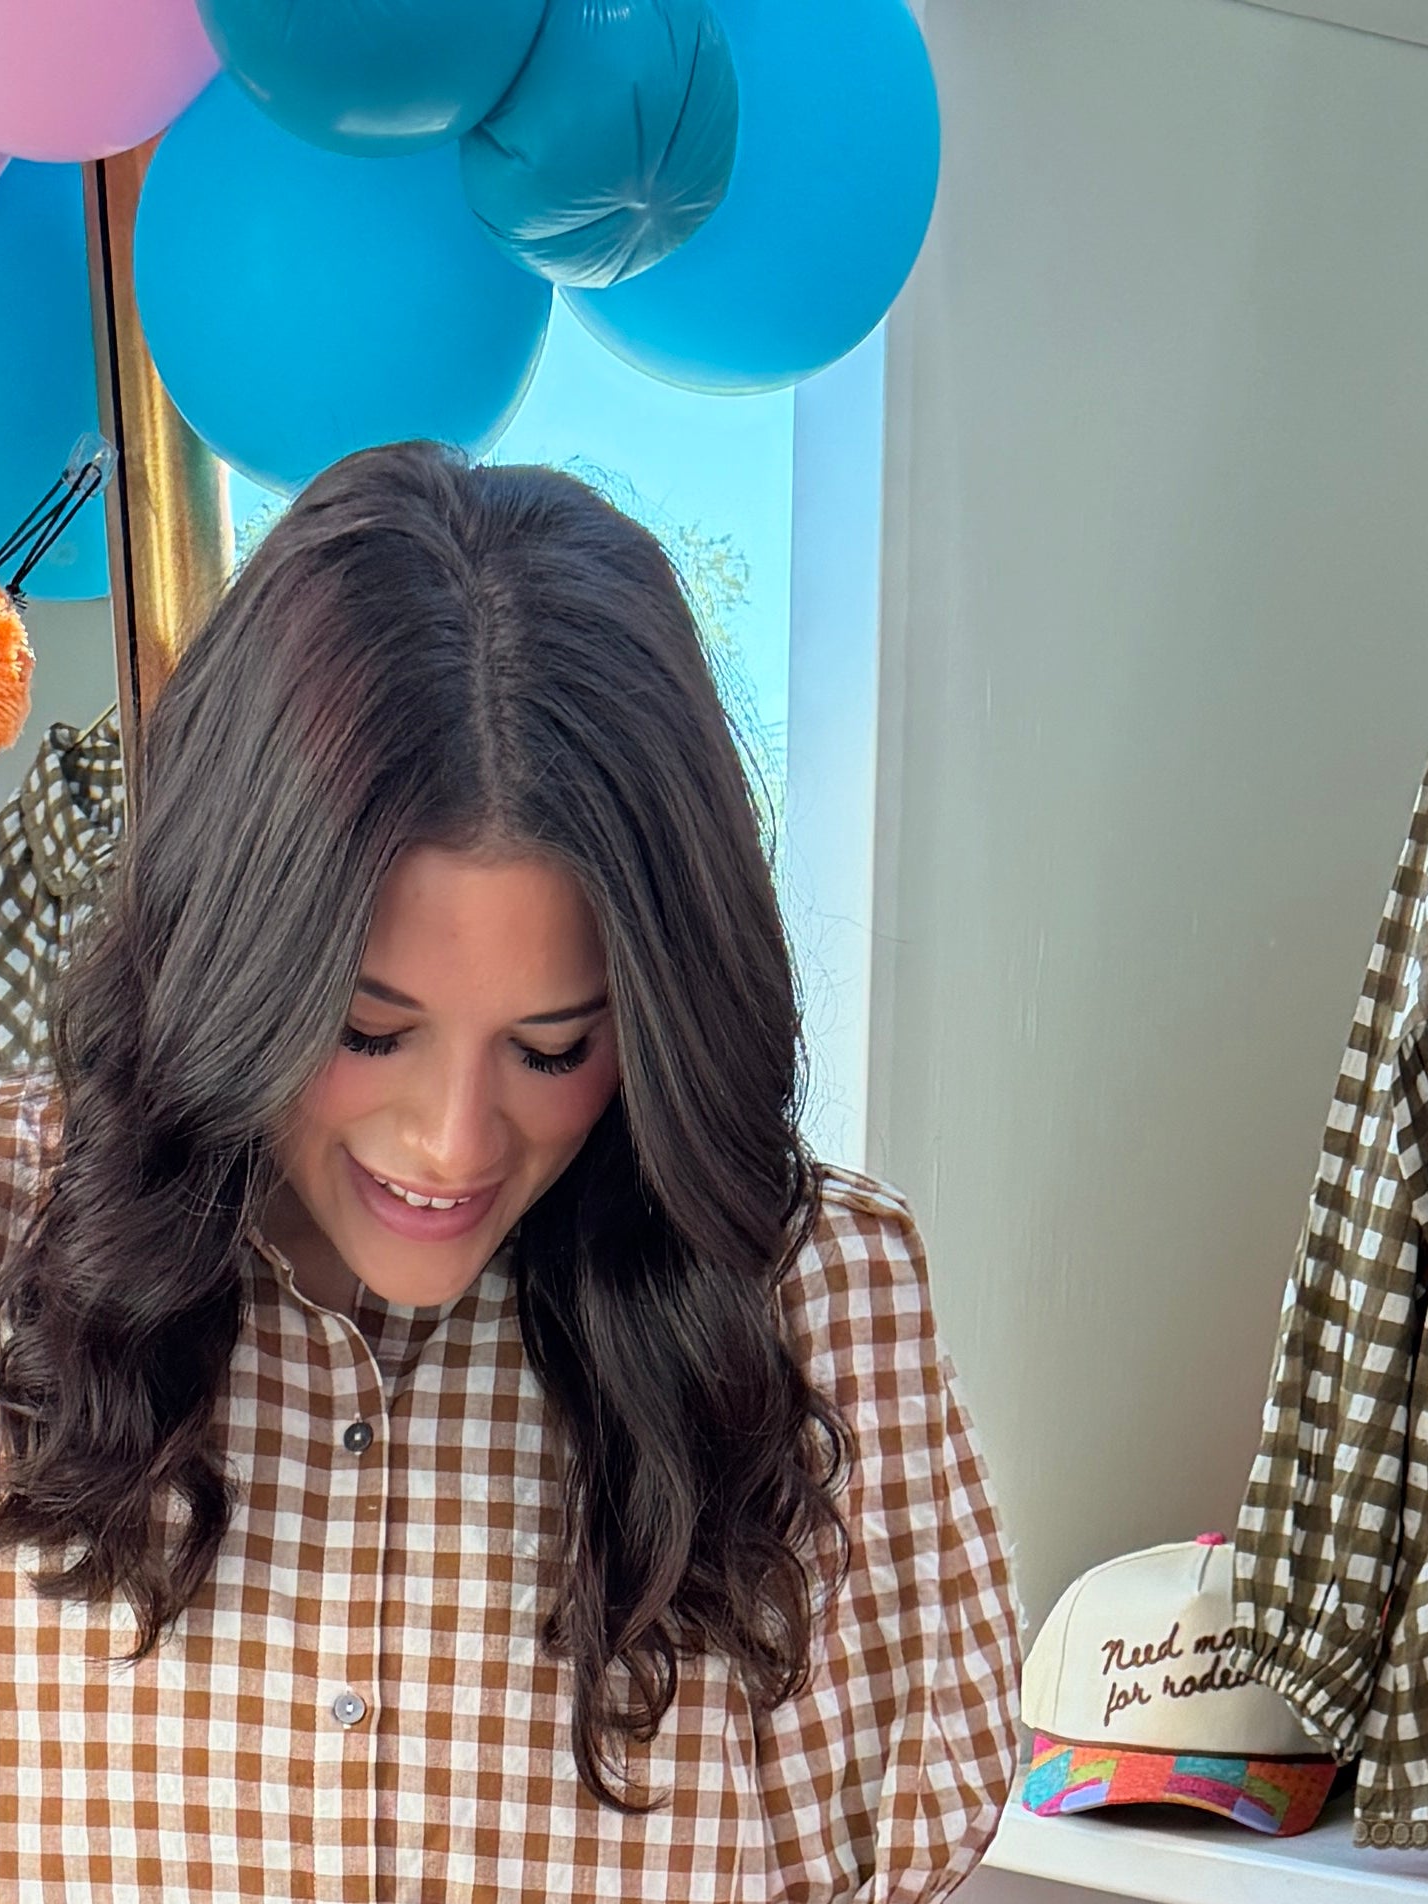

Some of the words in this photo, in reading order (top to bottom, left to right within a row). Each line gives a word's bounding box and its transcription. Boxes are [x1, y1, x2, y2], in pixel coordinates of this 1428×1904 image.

[1101, 1622, 1183, 1675] Need
[1193, 1627, 1236, 1654] mo
[1104, 1682, 1152, 1727] for
